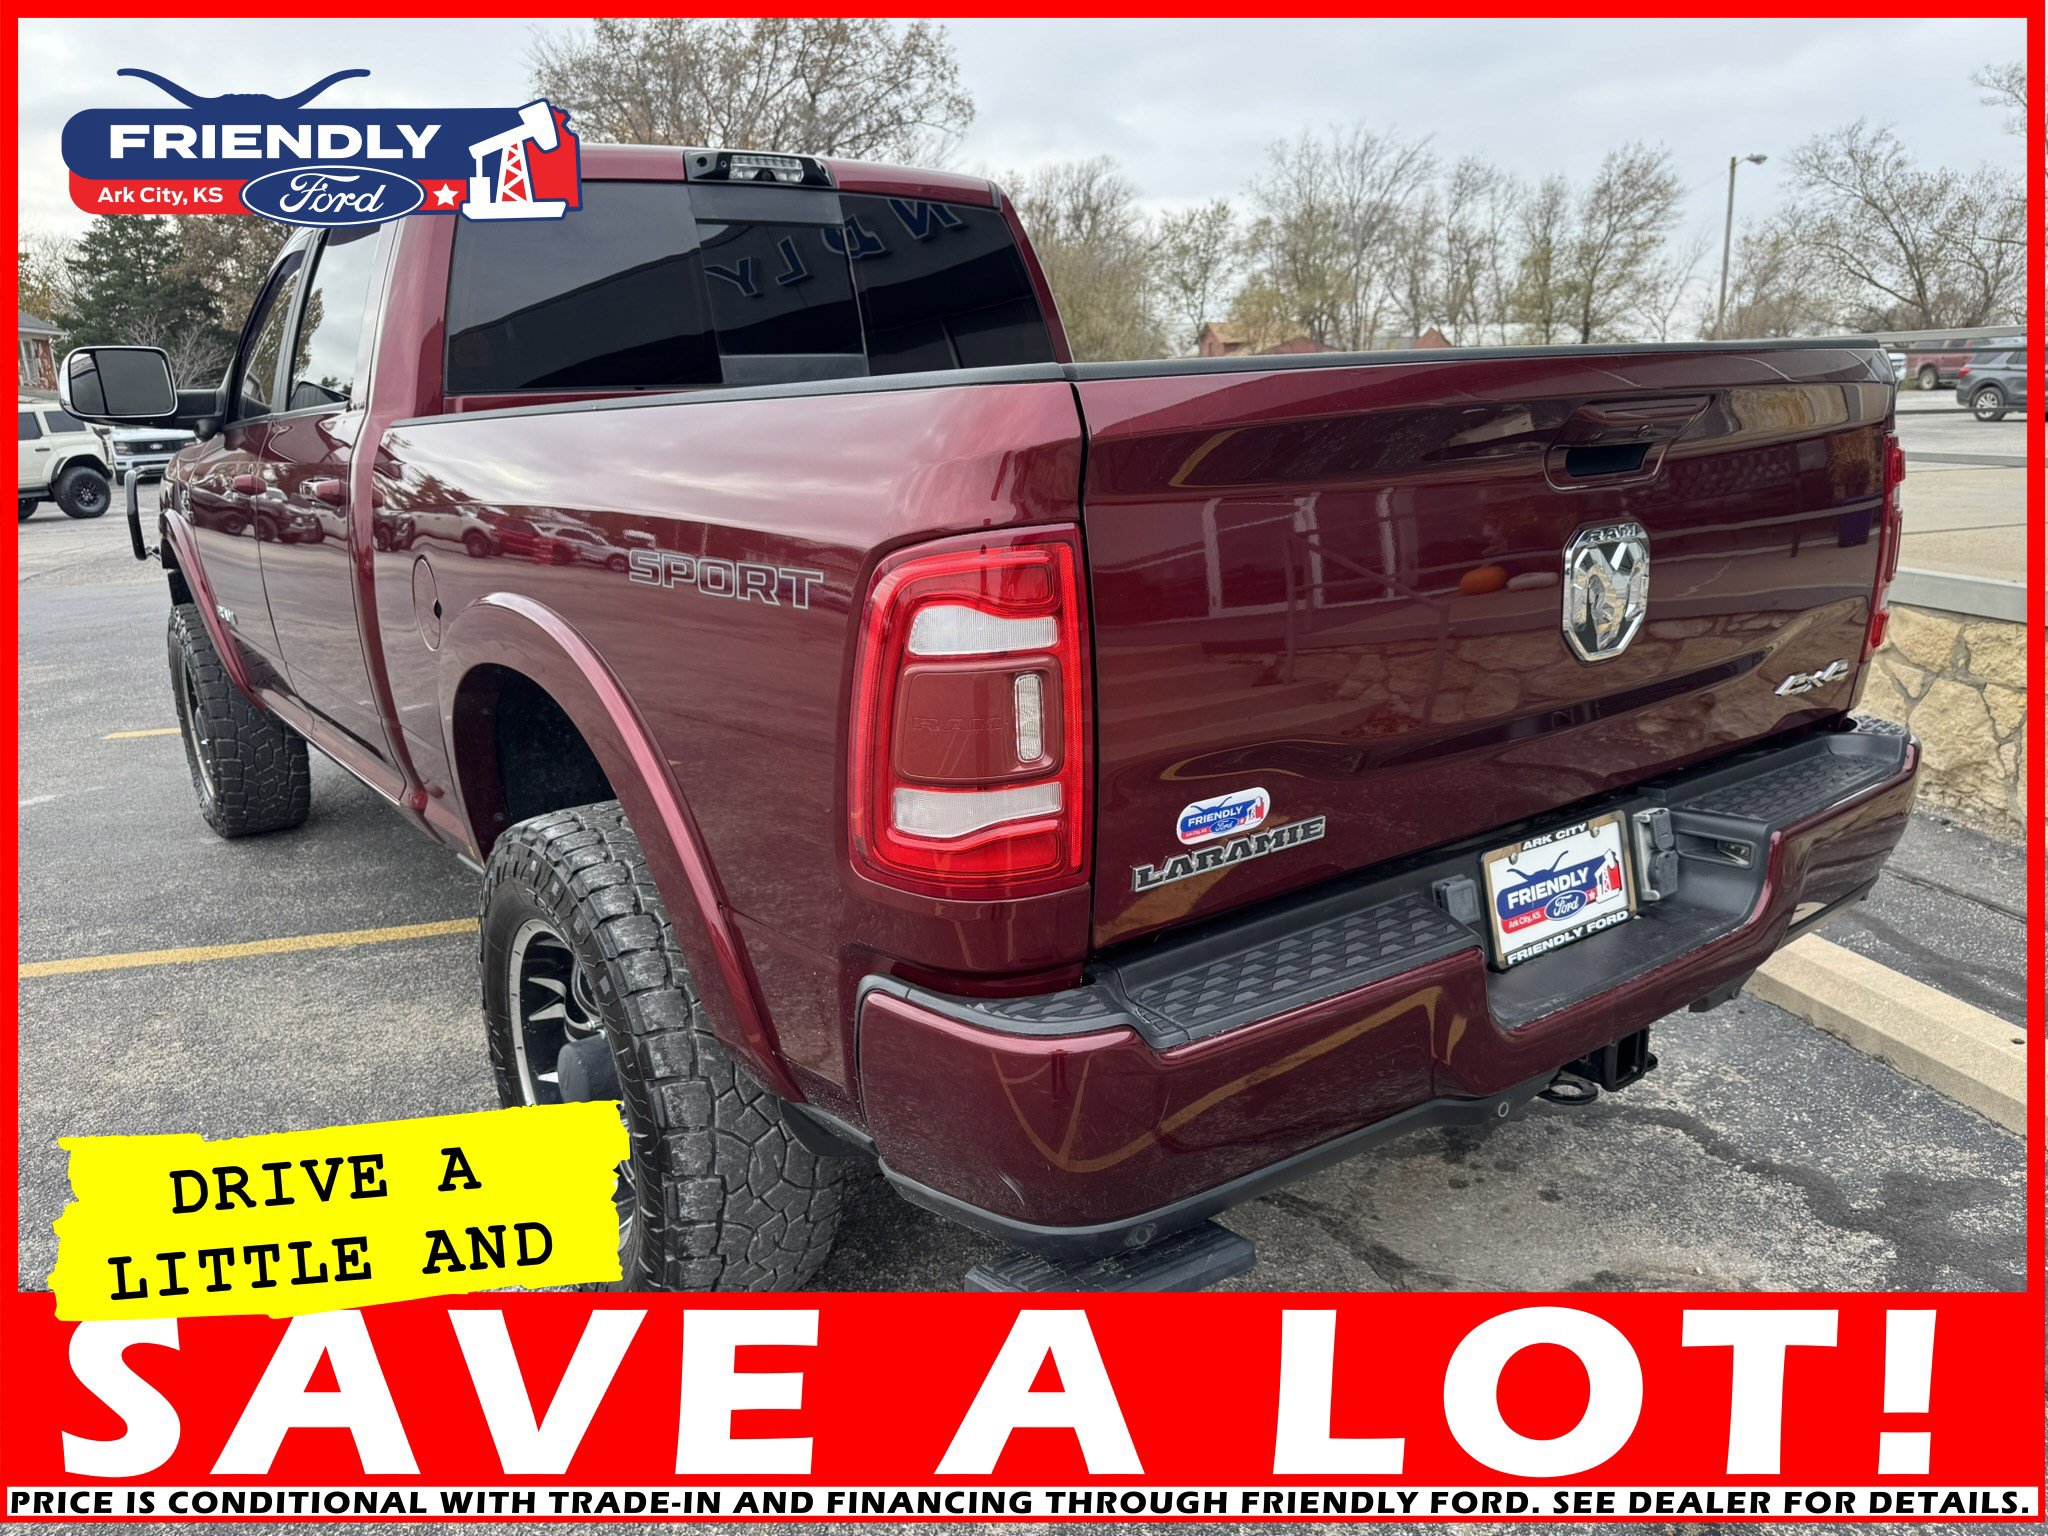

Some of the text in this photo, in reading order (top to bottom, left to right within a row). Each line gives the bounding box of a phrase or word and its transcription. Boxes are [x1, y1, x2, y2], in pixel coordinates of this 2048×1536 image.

[1587, 524, 1638, 542] RAM
[629, 548, 824, 610] SPORT
[912, 716, 1004, 732] RAM
[1188, 806, 1243, 827] FRIENDLY
[1214, 820, 1233, 831] Ford
[1522, 823, 1588, 851] ARK CITY
[1131, 815, 1326, 893] LARAMIE
[1507, 867, 1589, 910] FRIENDLY
[1553, 894, 1579, 917] Ford
[1508, 919, 1520, 929] Ark
[1532, 911, 1542, 920] KS
[1507, 910, 1629, 965] FRIENDLY FORD
